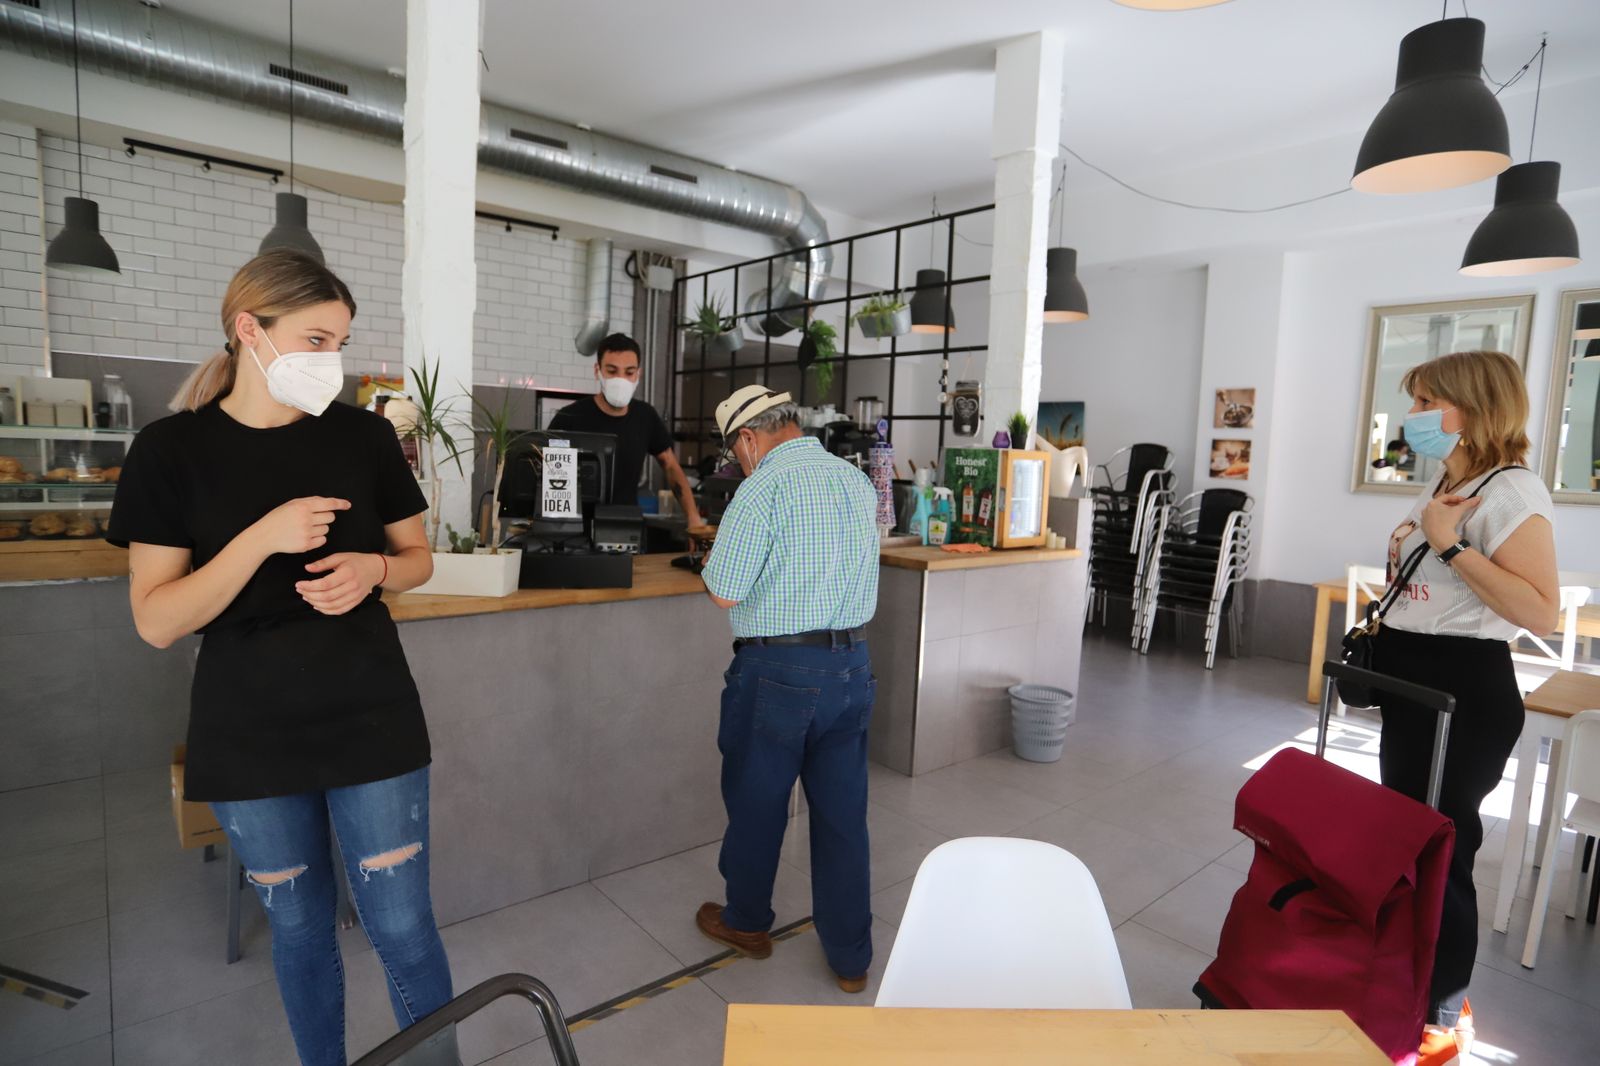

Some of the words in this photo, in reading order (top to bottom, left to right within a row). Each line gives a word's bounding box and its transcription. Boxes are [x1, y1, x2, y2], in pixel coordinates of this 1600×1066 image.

[545, 453, 572, 464] COFFEE
[955, 456, 987, 466] Honest
[963, 466, 978, 476] Bio
[544, 491, 550, 499] A
[552, 491, 572, 500] GOOD
[544, 500, 571, 512] IDEA
